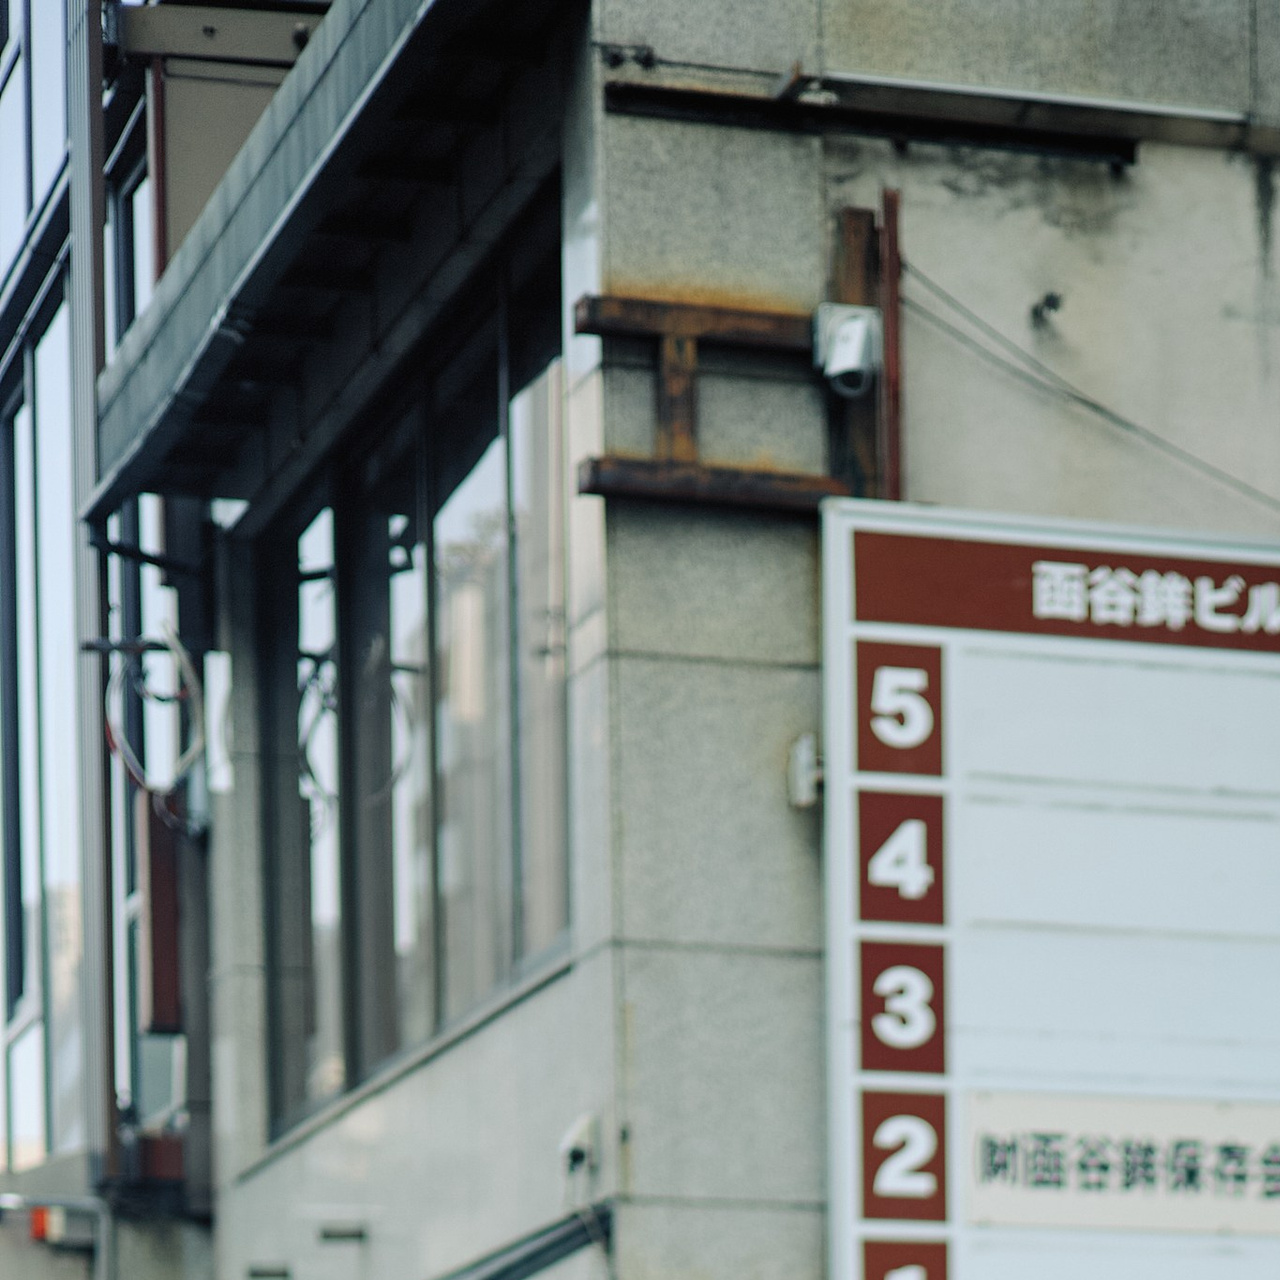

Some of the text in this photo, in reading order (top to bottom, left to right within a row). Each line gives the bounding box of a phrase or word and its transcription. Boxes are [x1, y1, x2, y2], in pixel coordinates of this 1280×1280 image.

[869, 665, 934, 749] 5
[868, 818, 935, 900] 4
[871, 965, 937, 1050] 3
[872, 1114, 938, 1199] 2
